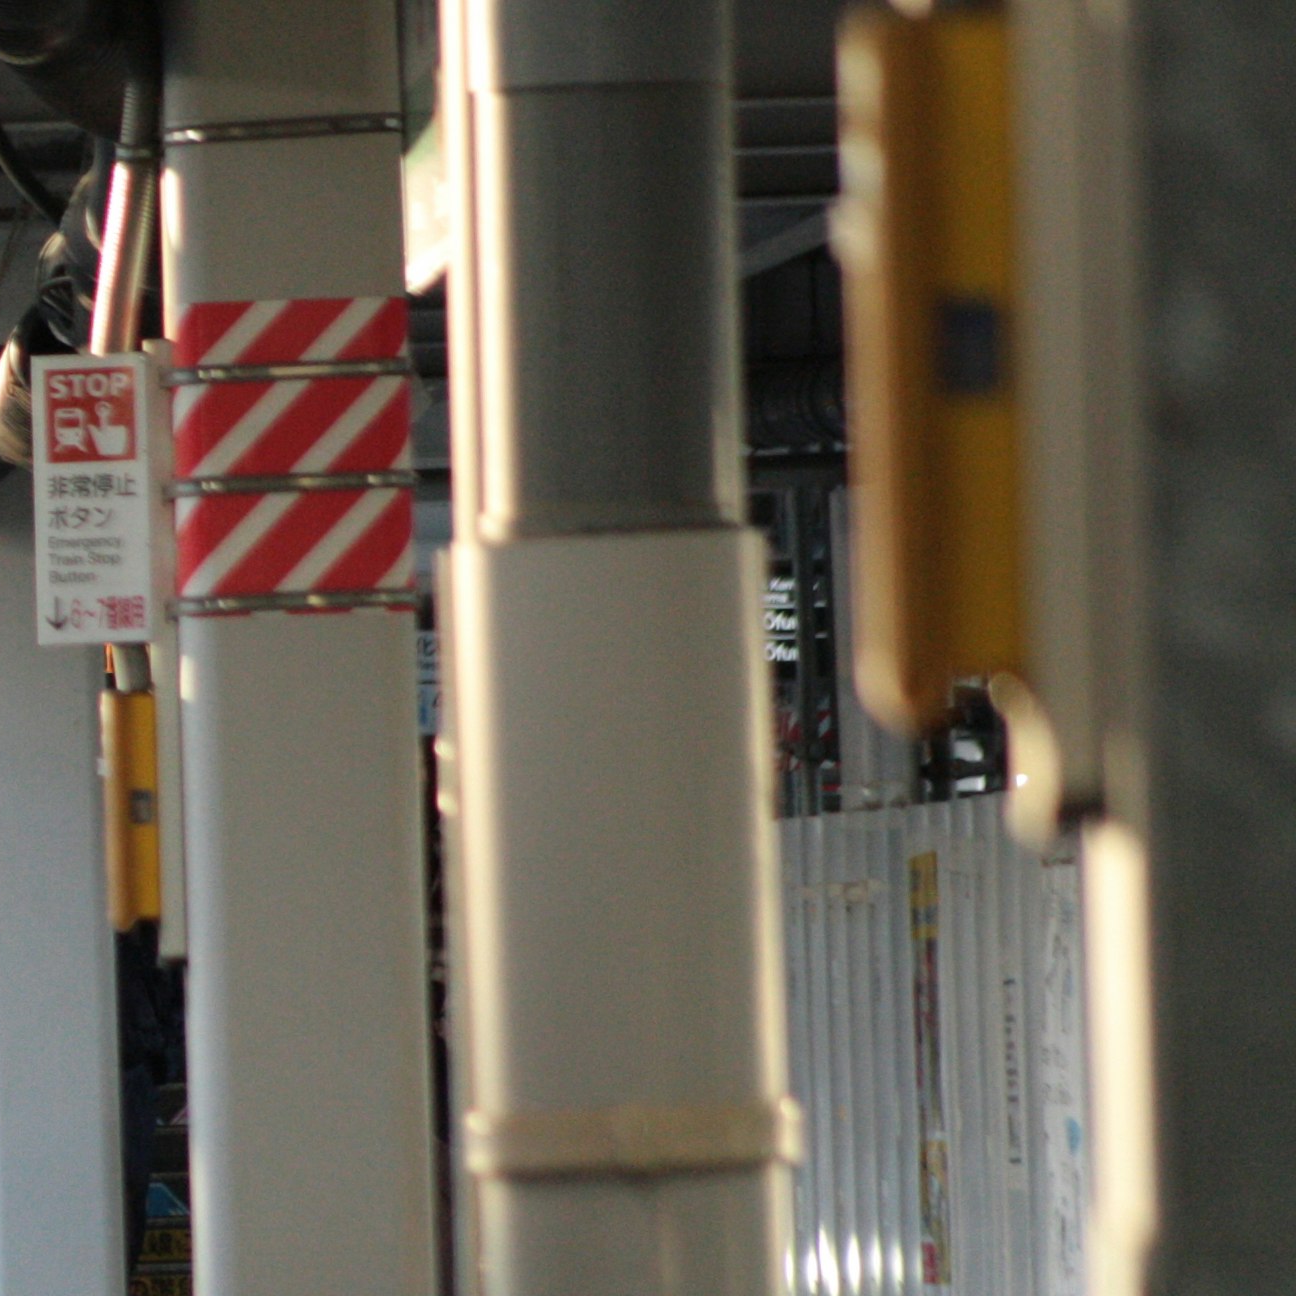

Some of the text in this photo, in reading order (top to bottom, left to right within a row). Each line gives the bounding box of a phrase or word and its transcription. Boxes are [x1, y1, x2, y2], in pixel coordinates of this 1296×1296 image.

[48, 373, 128, 399] STOP
[47, 473, 136, 498] 非常停止
[48, 507, 112, 529] ボタン
[47, 536, 122, 551] Emergency
[48, 551, 121, 566] Train Stop
[48, 570, 97, 584] Button
